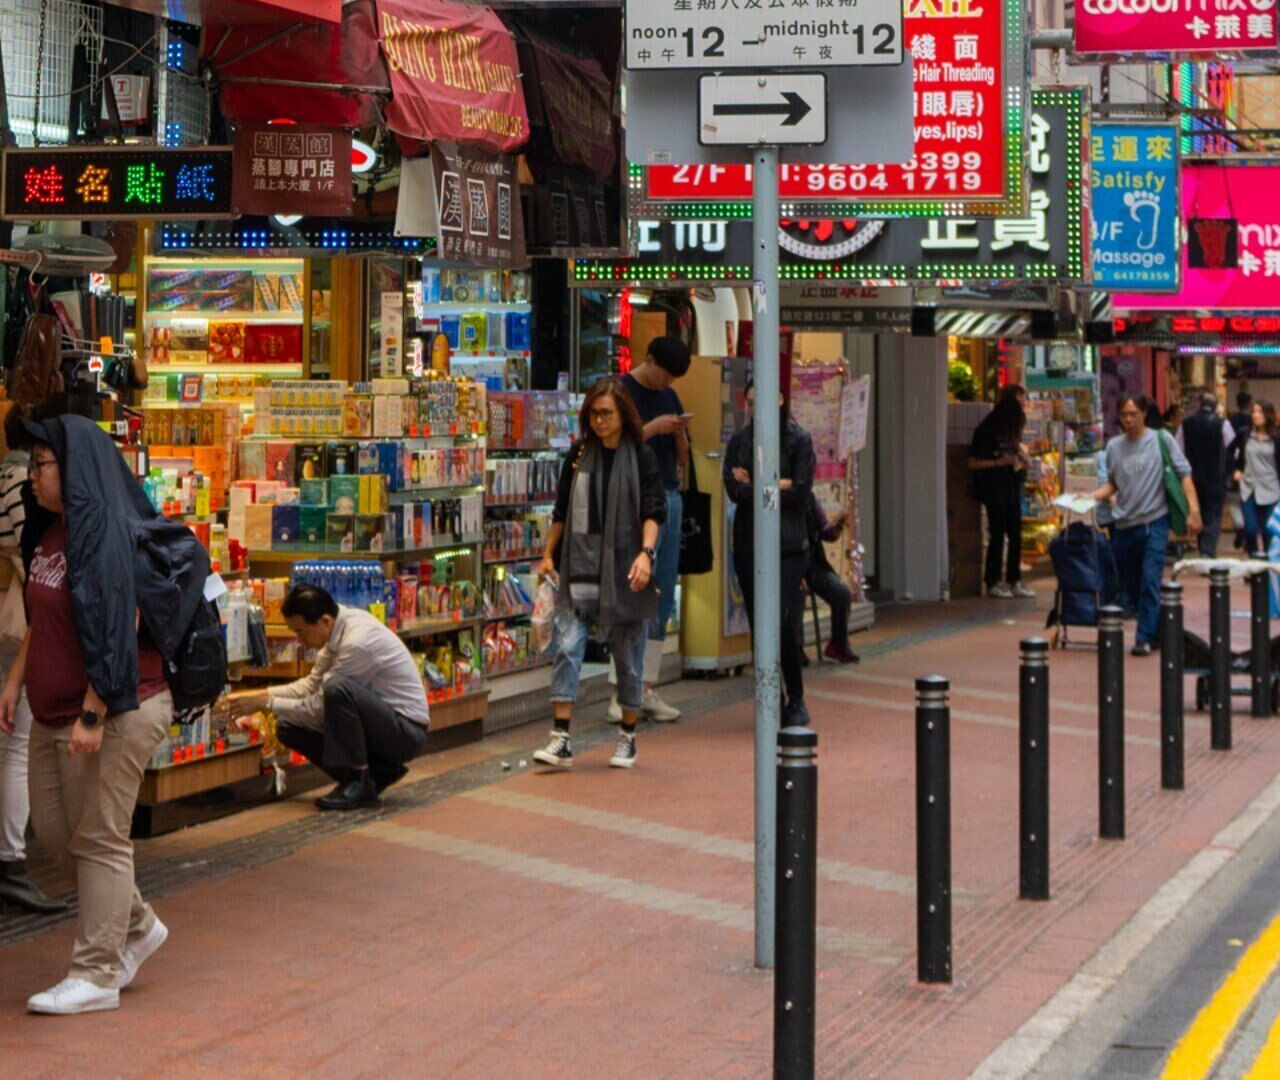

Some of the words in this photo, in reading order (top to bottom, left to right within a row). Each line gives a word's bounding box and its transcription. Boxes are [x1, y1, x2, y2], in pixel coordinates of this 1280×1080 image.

[632, 25, 678, 39] noon
[681, 25, 725, 58] 12
[763, 19, 849, 38] midnight
[852, 23, 895, 56] 12
[1185, 14, 1274, 40] 卡萊美
[637, 48, 676, 62] 中午
[793, 44, 834, 60] 午夜
[919, 63, 941, 83] Hair
[941, 62, 995, 86] Threading
[913, 91, 984, 118] 眼唇)
[23, 162, 215, 205] 姓名貼紙
[807, 172, 889, 191] 9604
[901, 172, 982, 191] 1719
